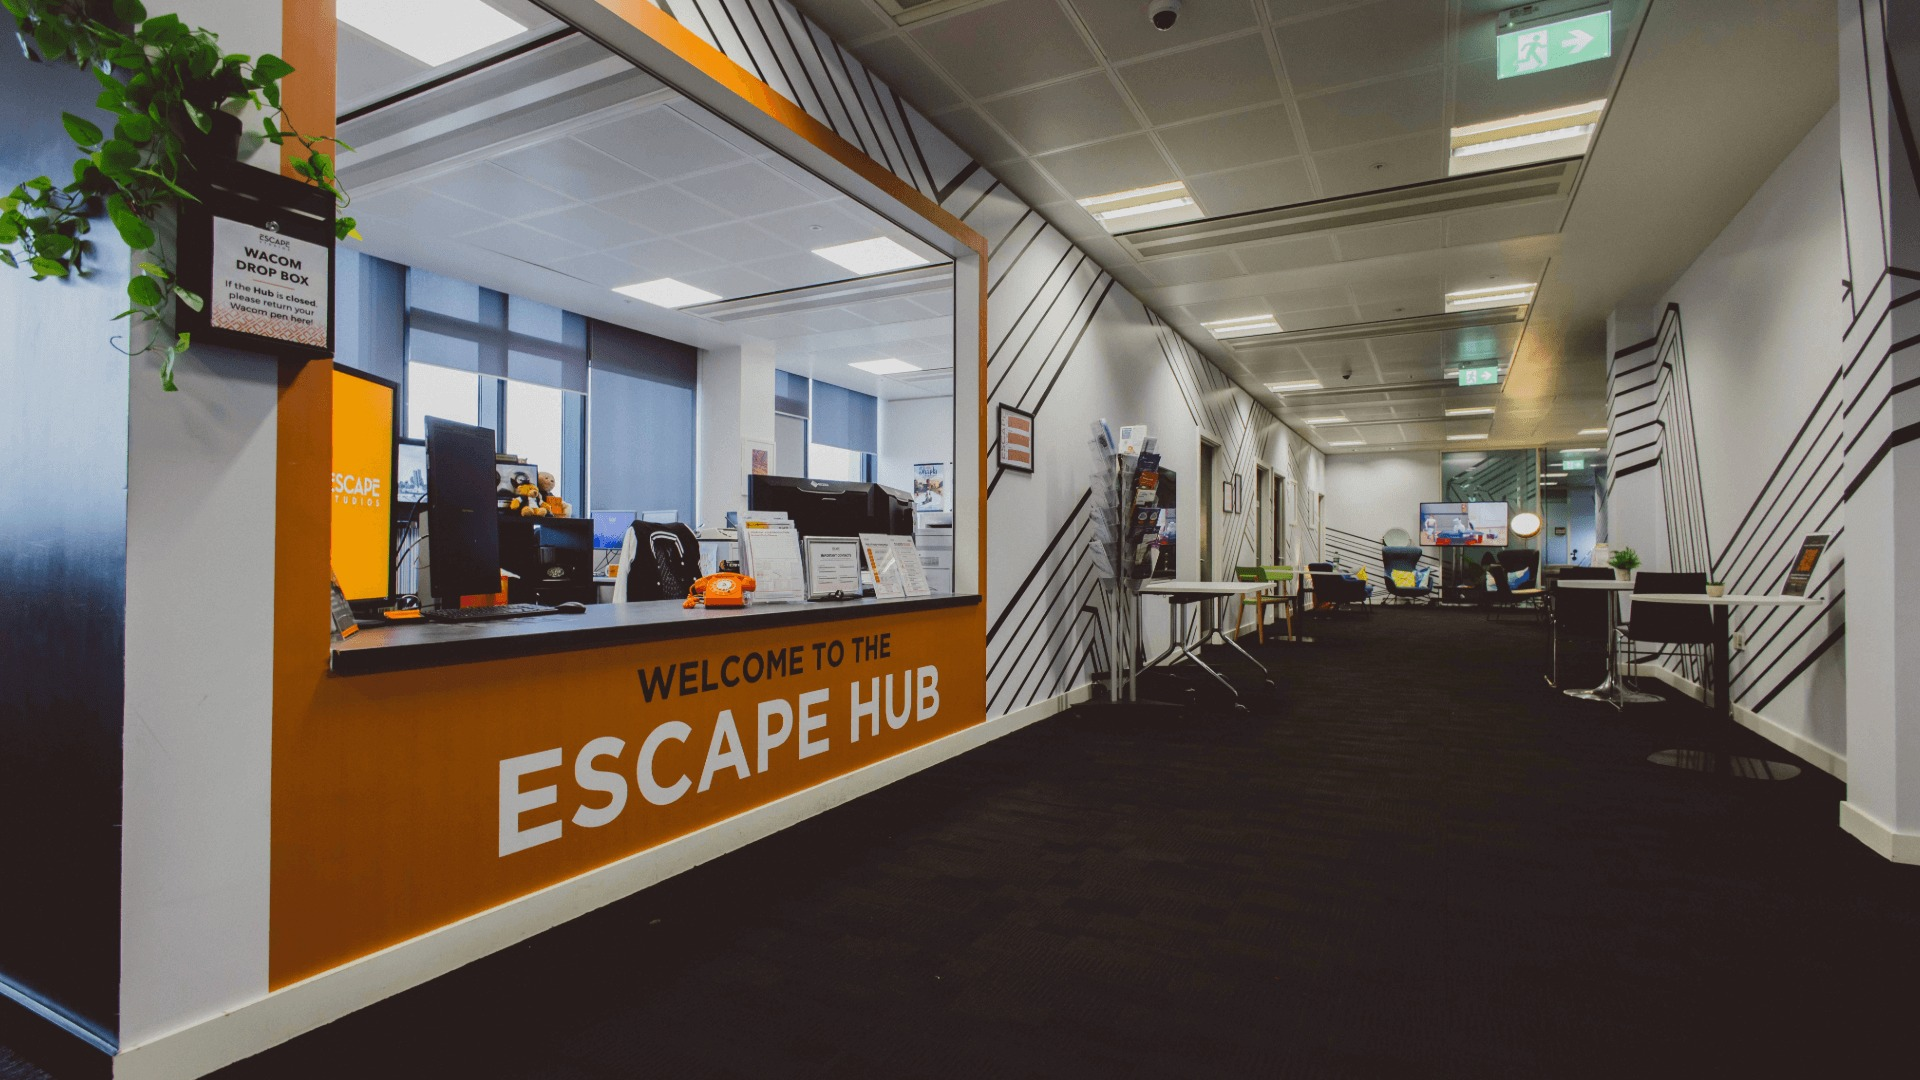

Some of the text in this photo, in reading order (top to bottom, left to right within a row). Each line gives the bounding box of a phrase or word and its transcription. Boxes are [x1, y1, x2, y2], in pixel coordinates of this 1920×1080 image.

[259, 234, 290, 248] ESCAPE
[244, 246, 302, 270] WACOM
[236, 259, 309, 286] DROP BOX
[225, 280, 232, 288] If
[234, 281, 251, 292] the
[253, 286, 274, 298] Hub
[276, 291, 284, 300] is
[229, 292, 315, 316] please return your
[230, 302, 314, 325] Wacom pen here!
[335, 495, 380, 507] TUDIOS
[637, 633, 892, 703] WELCOME TO THE
[499, 664, 941, 858] ESCAPE HUB
